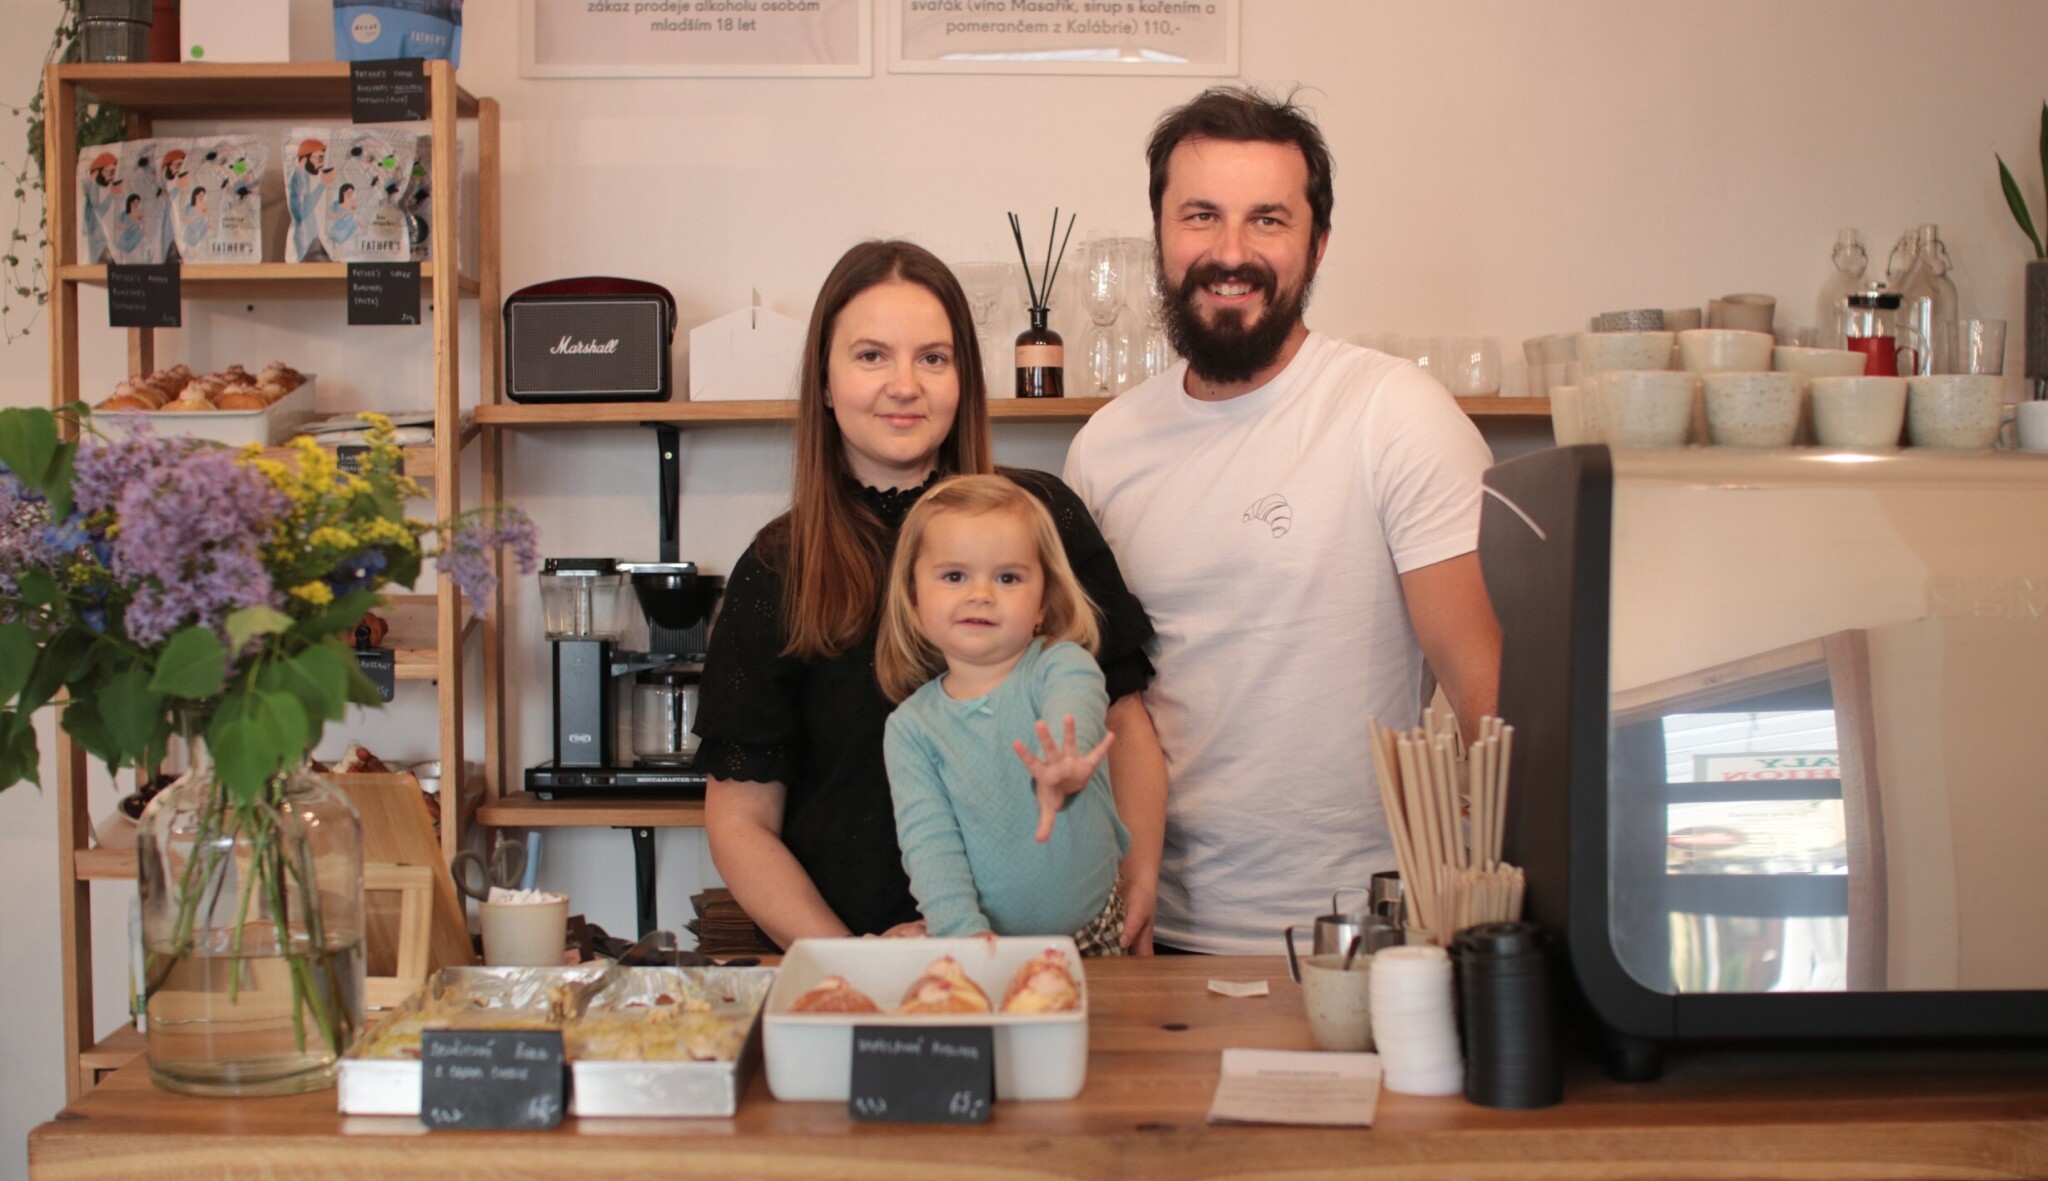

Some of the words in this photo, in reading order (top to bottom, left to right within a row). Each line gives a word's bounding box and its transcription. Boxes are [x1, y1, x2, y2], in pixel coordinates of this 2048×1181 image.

[587, 0, 630, 12] zákaz
[634, 0, 690, 15] prodeje
[694, 0, 757, 12] alkoholu
[1126, 4, 1135, 13] s
[1139, 0, 1201, 14] kořením
[1205, 4, 1216, 14] a
[650, 18, 712, 31] mladším
[717, 18, 734, 31] 18
[738, 17, 756, 31] let
[946, 20, 1048, 35] pomerančem
[1053, 23, 1062, 33] z
[1066, 18, 1138, 35] Kalábrie)
[1144, 20, 1181, 36] 110,-
[212, 242, 253, 253] FATHER'S
[361, 240, 401, 251] FATHER'S
[550, 335, 619, 355] Marshall
